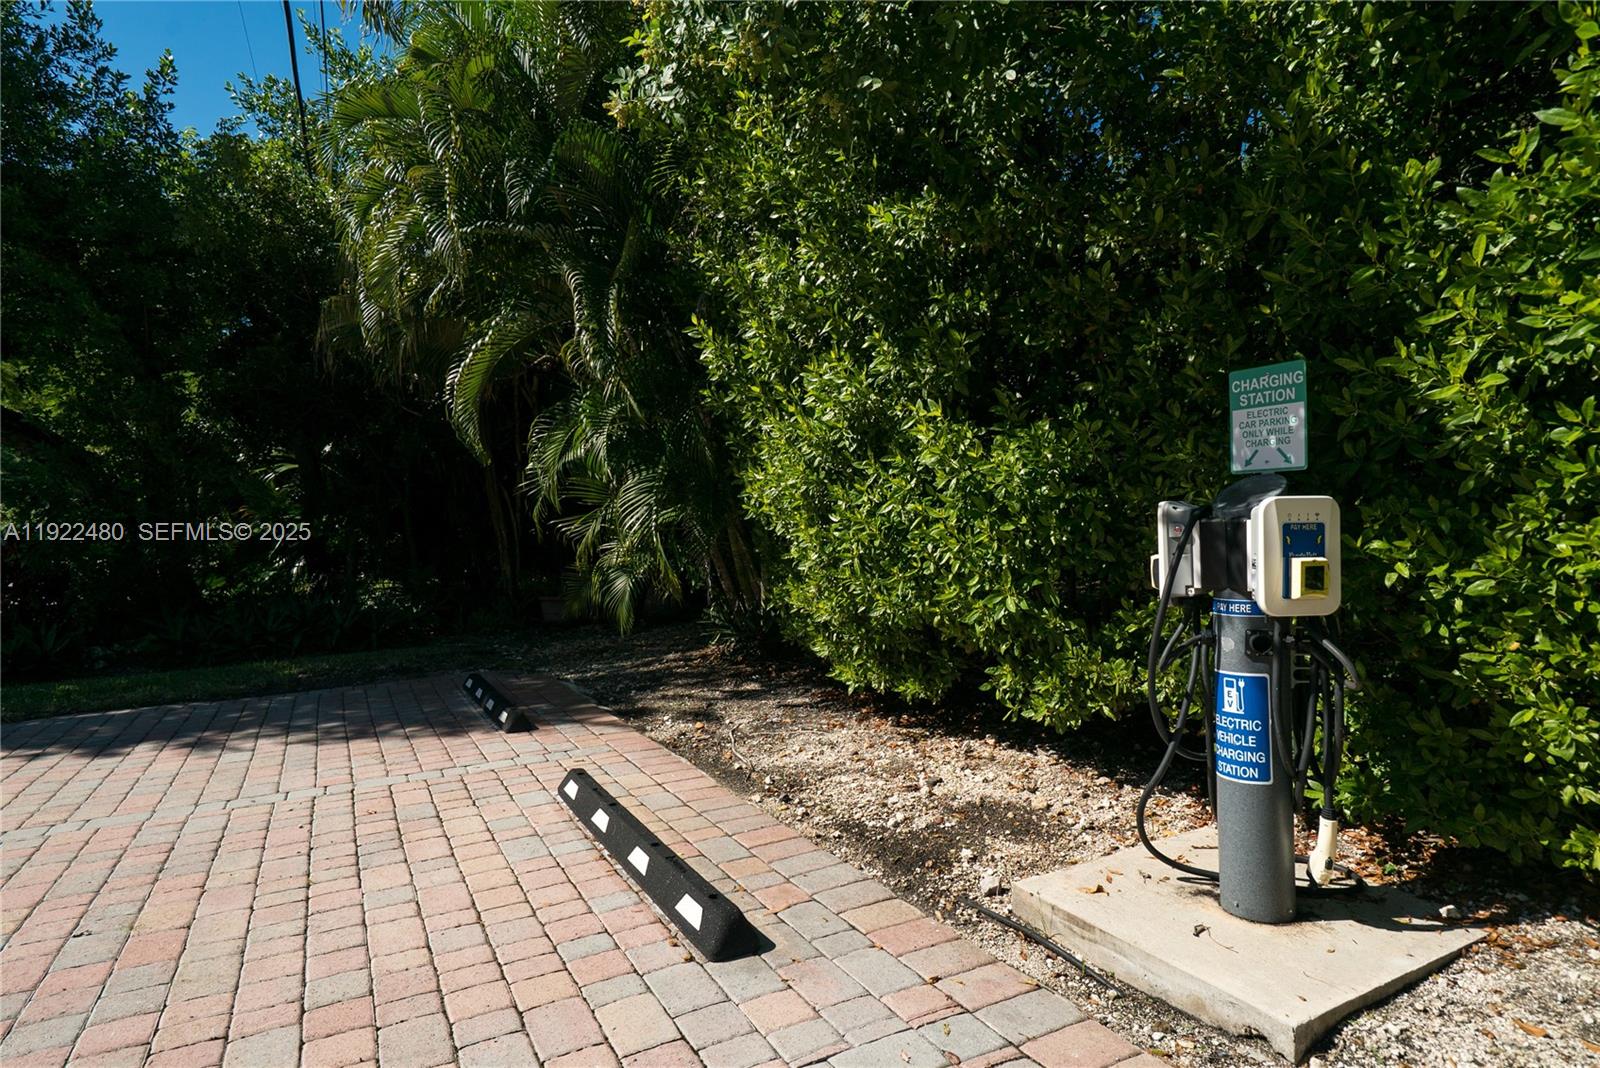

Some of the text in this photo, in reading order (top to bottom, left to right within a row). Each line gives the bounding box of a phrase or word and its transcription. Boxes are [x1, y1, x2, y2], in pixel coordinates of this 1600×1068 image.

[1231, 370, 1304, 393] CHARGING
[1240, 387, 1296, 407] STATION
[1246, 406, 1289, 419] ELECTRIC
[1238, 416, 1298, 430] CAR PARKING
[1242, 425, 1295, 439] ONLY WHILE
[1245, 436, 1291, 449] CHARGING
[1302, 523, 1318, 531] HERE
[1216, 602, 1252, 613] PAY HERE
[1215, 714, 1262, 732] ELECTRIC
[1216, 731, 1257, 747] VEHICLE
[1216, 744, 1266, 764] CHARGING
[1217, 760, 1259, 779] STATION
